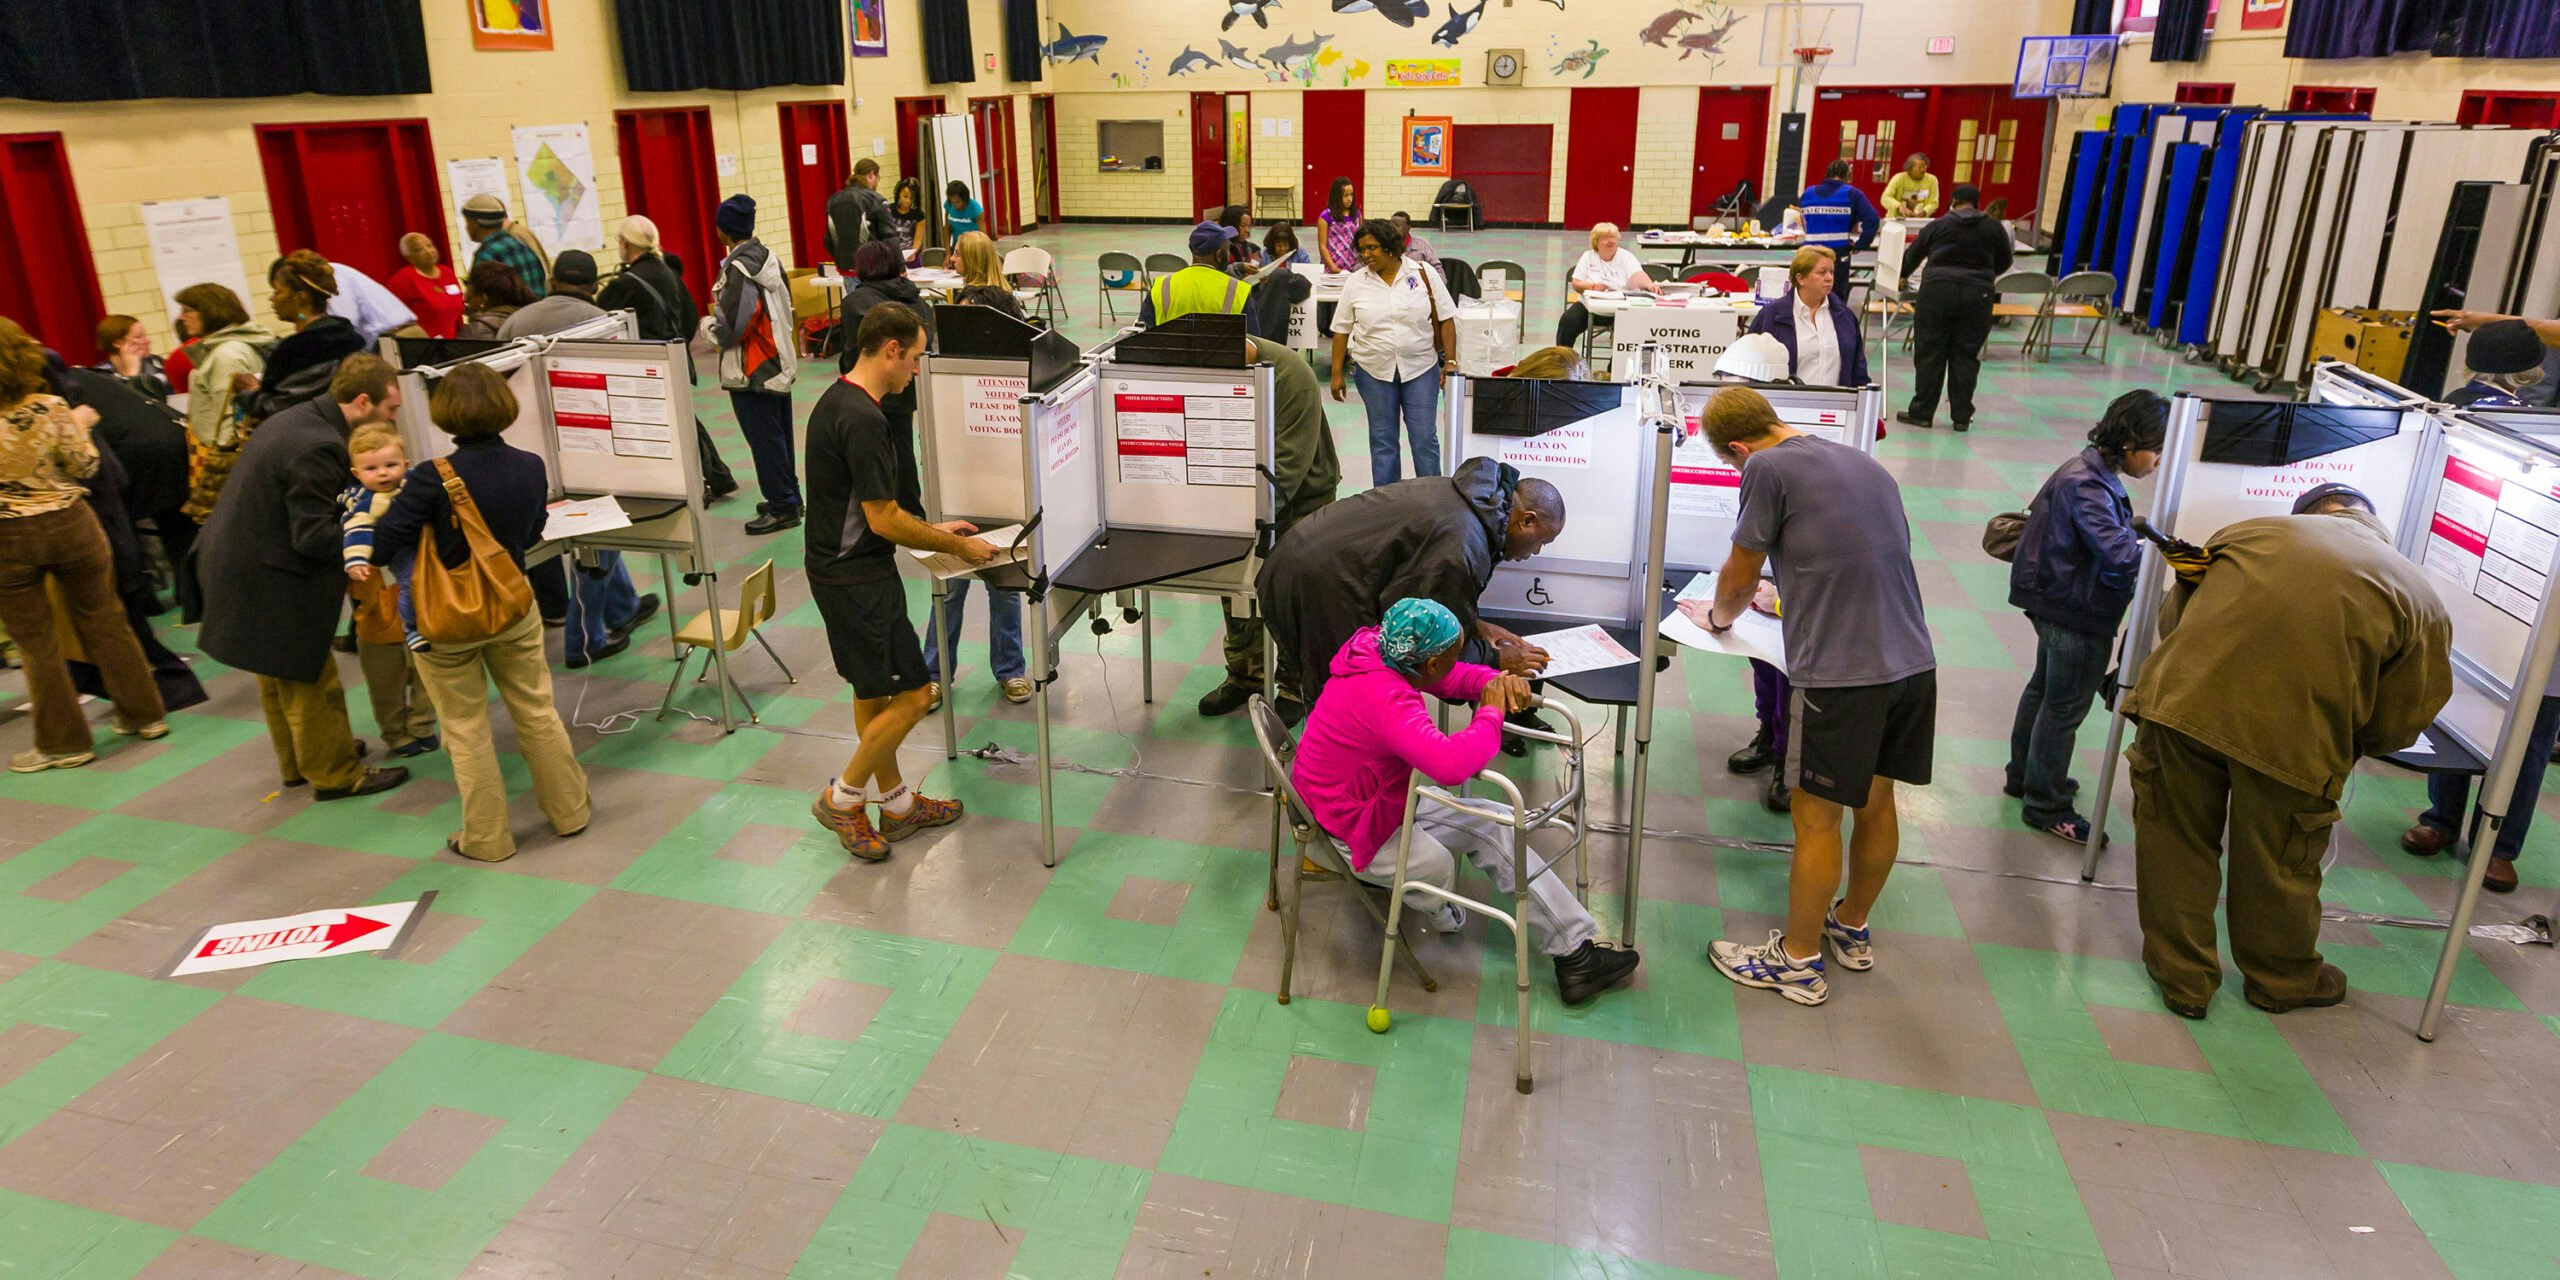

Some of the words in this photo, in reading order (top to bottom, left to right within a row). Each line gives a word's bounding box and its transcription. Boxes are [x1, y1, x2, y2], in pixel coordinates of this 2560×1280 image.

[1650, 328, 1700, 338] VOTING
[1617, 343, 1727, 354] DESTRATIO
[1669, 360, 1694, 369] ERK
[977, 379, 1025, 388] ATTENTION
[985, 391, 1018, 399] VOTERS
[969, 402, 1001, 410] PLEASE
[985, 414, 1006, 422] LEAN
[969, 425, 1001, 433] VOTING
[1565, 430, 1585, 438] NOT
[1523, 441, 1549, 449] LEAN
[1552, 442, 1567, 450] ON
[1503, 452, 1541, 462] VOTING
[1545, 455, 1587, 464] BOOTHS
[2305, 461, 2325, 470] DO
[2329, 462, 2355, 472] NOT
[2273, 475, 2306, 484] LEAN
[2246, 487, 2294, 498] VOTING
[210, 924, 331, 955] VOTING
